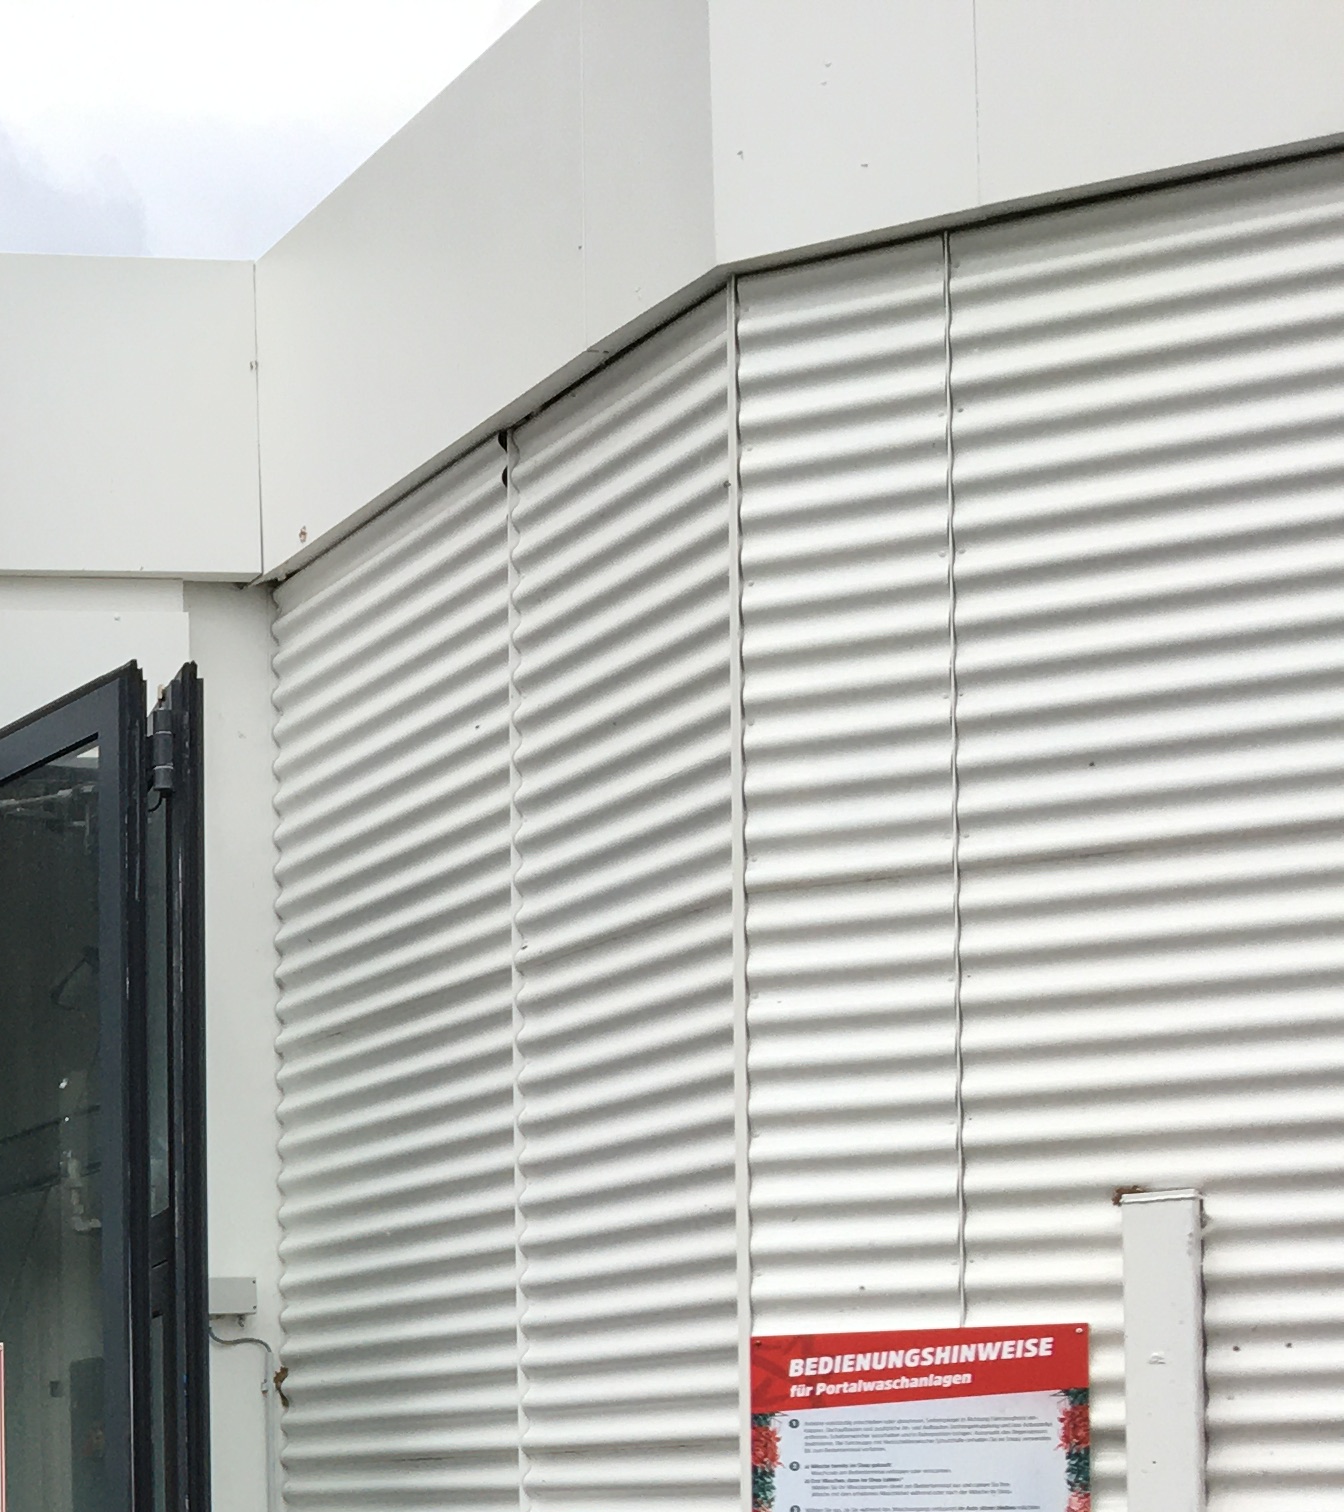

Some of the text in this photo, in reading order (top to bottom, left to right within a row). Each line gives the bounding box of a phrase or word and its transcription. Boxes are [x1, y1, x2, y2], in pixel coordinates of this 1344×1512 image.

[788, 1337, 1054, 1377] BEDIENUNGSHINWEISE
[790, 1373, 972, 1398] für Portalwaschanlagen
